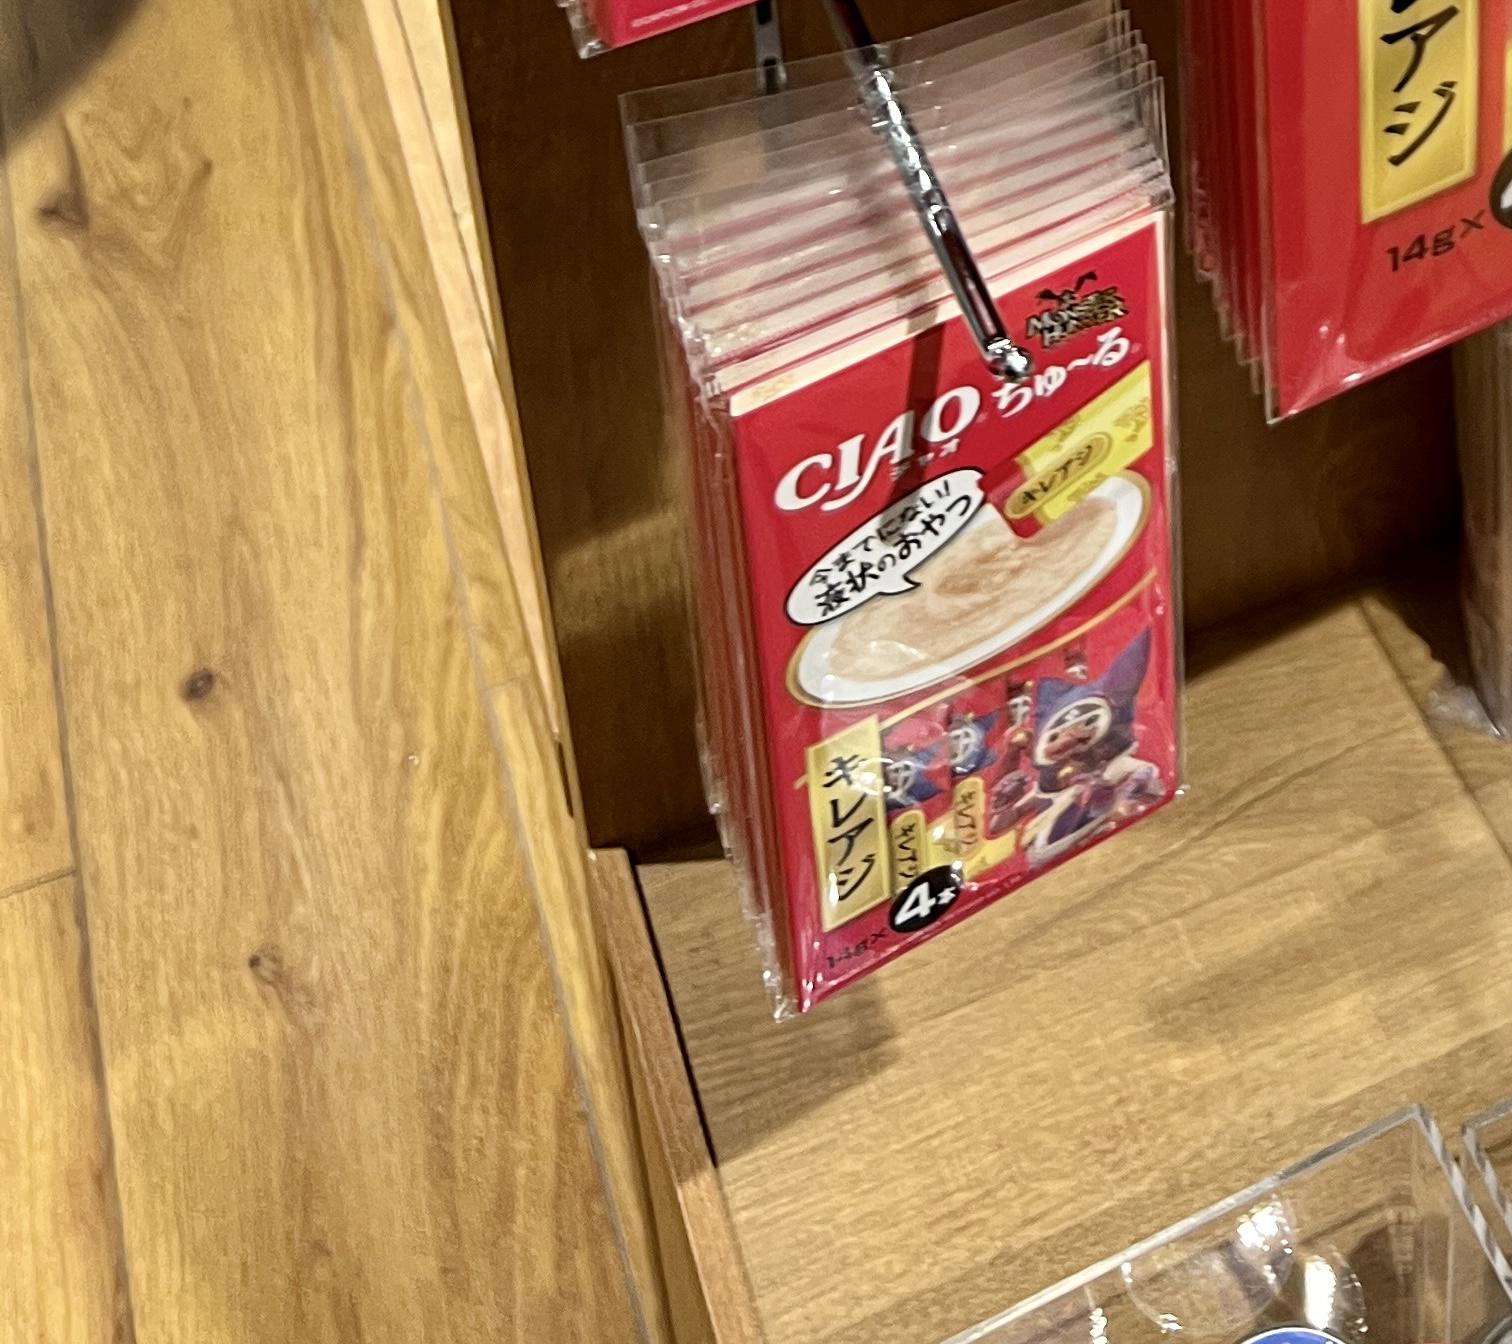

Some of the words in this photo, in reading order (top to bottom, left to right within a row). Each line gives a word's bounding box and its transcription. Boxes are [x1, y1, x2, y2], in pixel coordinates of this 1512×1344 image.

[774, 385, 982, 512] CIAO
[821, 753, 876, 902] キレアジ
